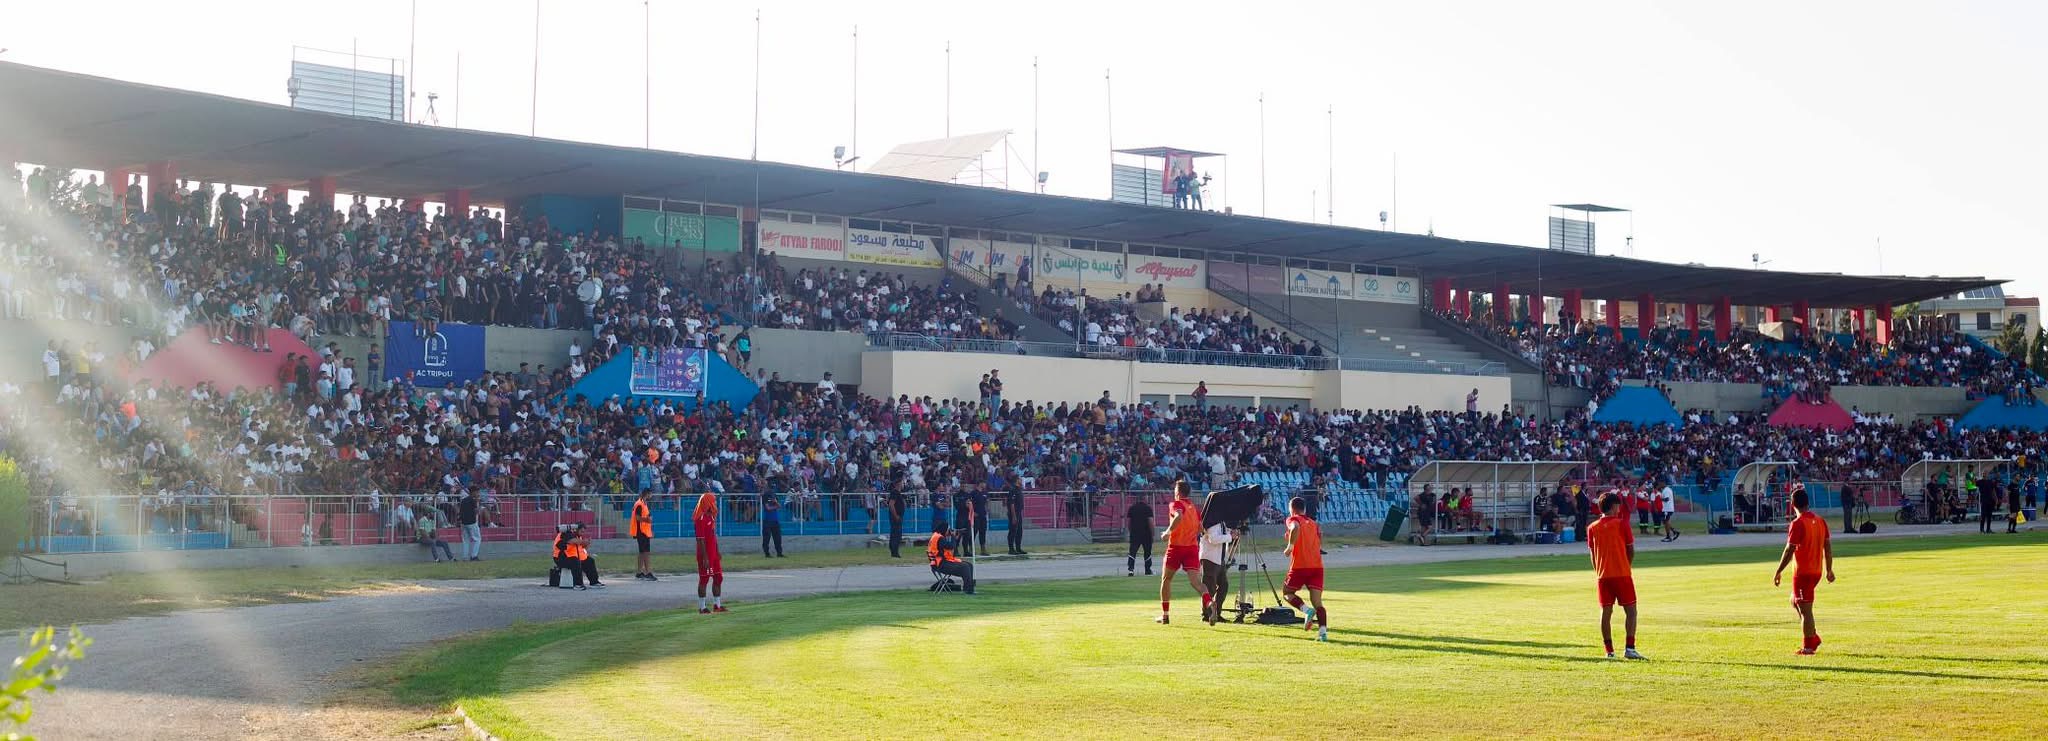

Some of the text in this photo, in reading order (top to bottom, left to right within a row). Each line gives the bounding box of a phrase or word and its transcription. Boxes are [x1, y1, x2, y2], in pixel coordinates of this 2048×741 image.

[780, 235, 808, 249] ATYAB
[850, 232, 925, 251] مطبعة مسعود
[1055, 257, 1113, 273] بلدية طرابلس
[1135, 261, 1198, 281] Alfayssal
[416, 369, 426, 377] AC
